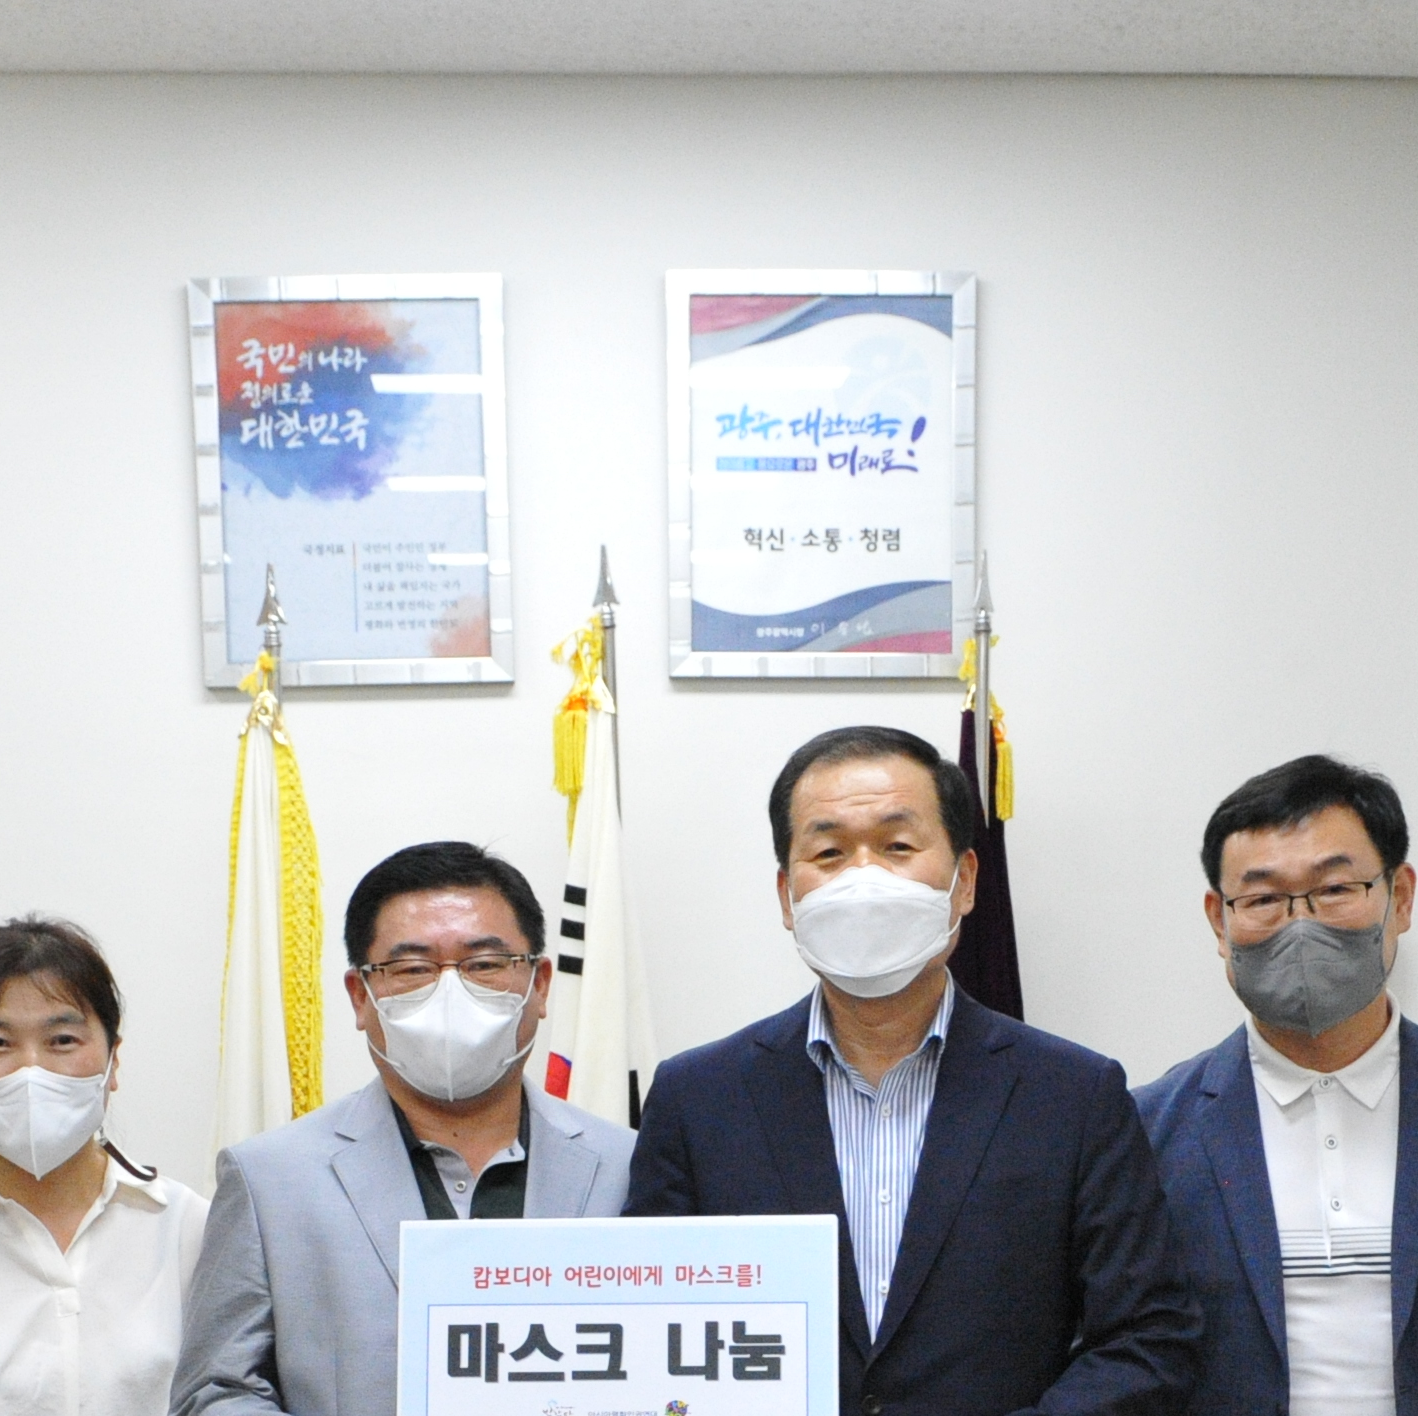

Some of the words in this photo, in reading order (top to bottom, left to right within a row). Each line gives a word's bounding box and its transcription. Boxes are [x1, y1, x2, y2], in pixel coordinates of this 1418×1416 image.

[236, 338, 313, 378] 국민의
[318, 346, 367, 374] 나라
[241, 381, 314, 406] 정의로운
[240, 408, 370, 451] 대한민국
[788, 407, 902, 447] 대한민국
[743, 527, 785, 552] 혁신
[801, 527, 842, 551] 소통
[859, 527, 901, 552] 청렴
[473, 1265, 552, 1289] 캄보디아
[564, 1265, 664, 1289] 어린이에게
[674, 1264, 762, 1288] 마스크를!
[447, 1322, 628, 1383] 마스크
[667, 1320, 786, 1381] 나눔
